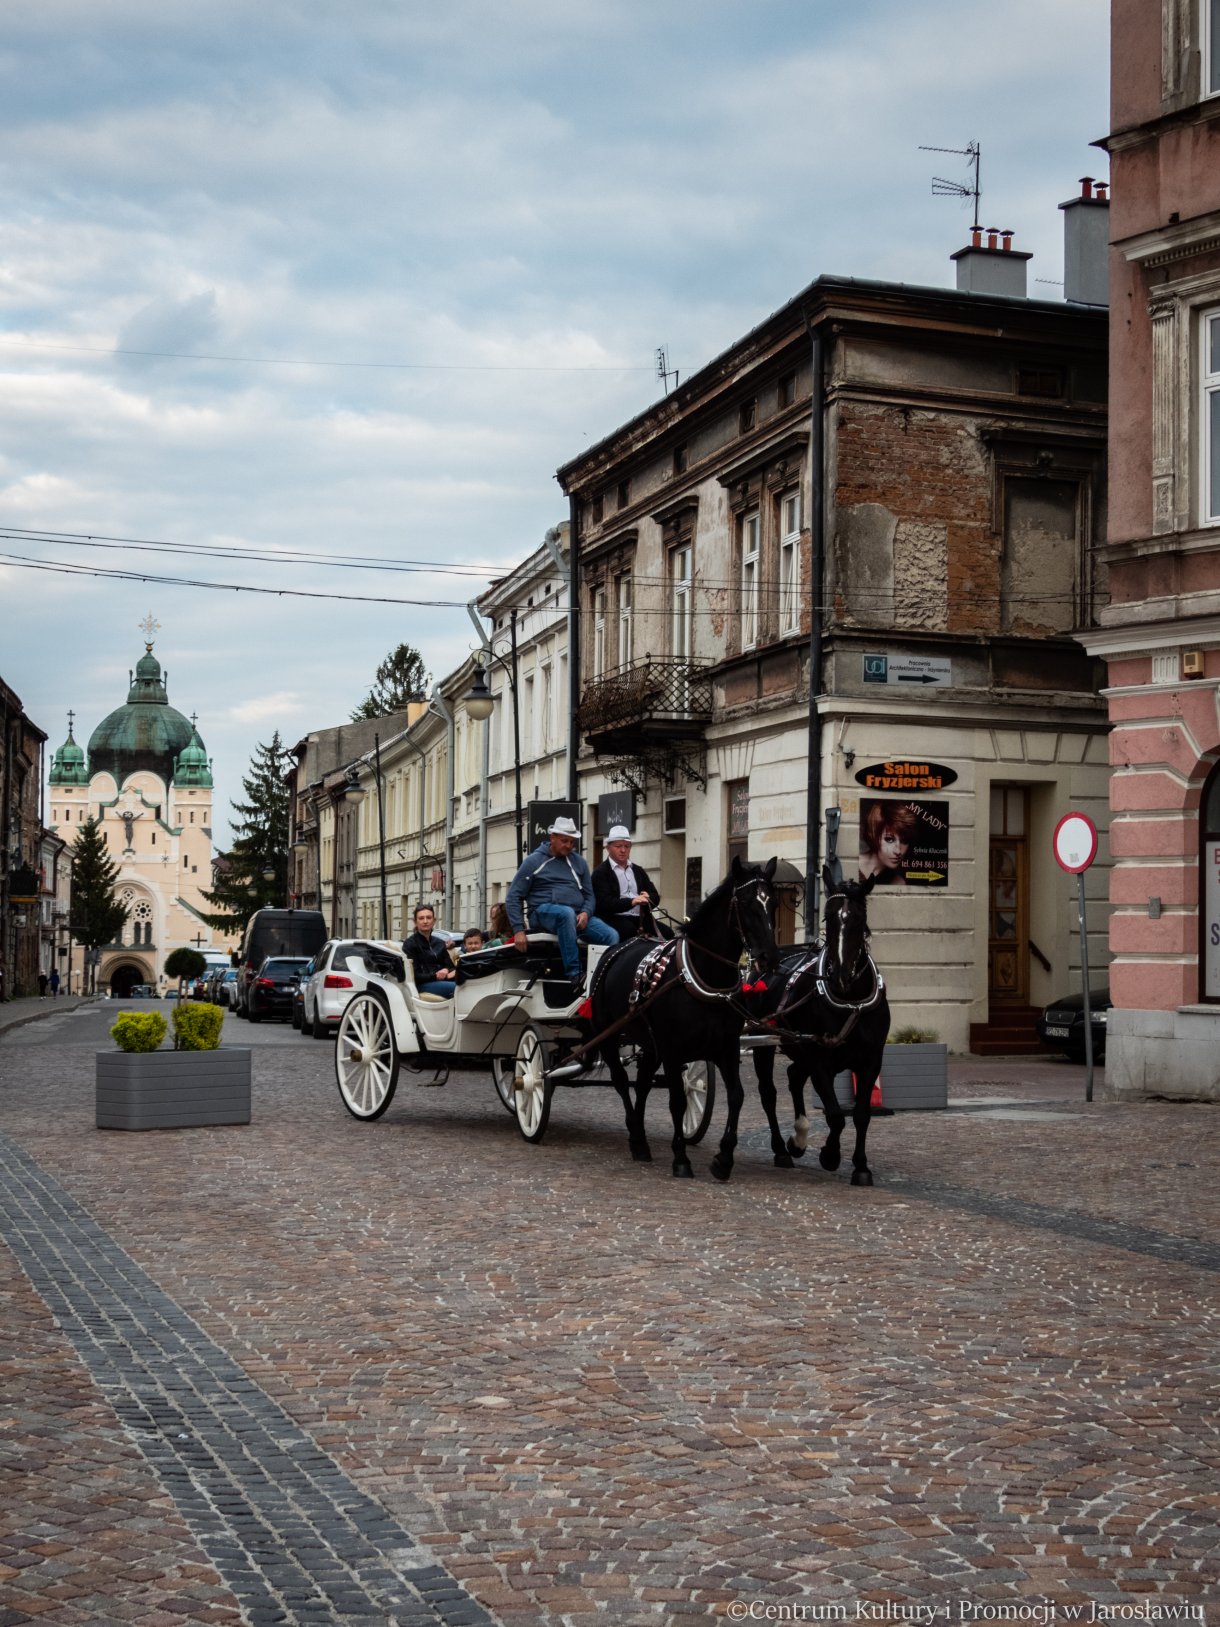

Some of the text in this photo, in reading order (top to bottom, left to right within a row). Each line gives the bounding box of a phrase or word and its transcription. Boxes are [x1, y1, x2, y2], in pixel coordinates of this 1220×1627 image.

[884, 762, 929, 775] Salon
[866, 775, 942, 789] Fryzjerski
[911, 860, 923, 868] 694
